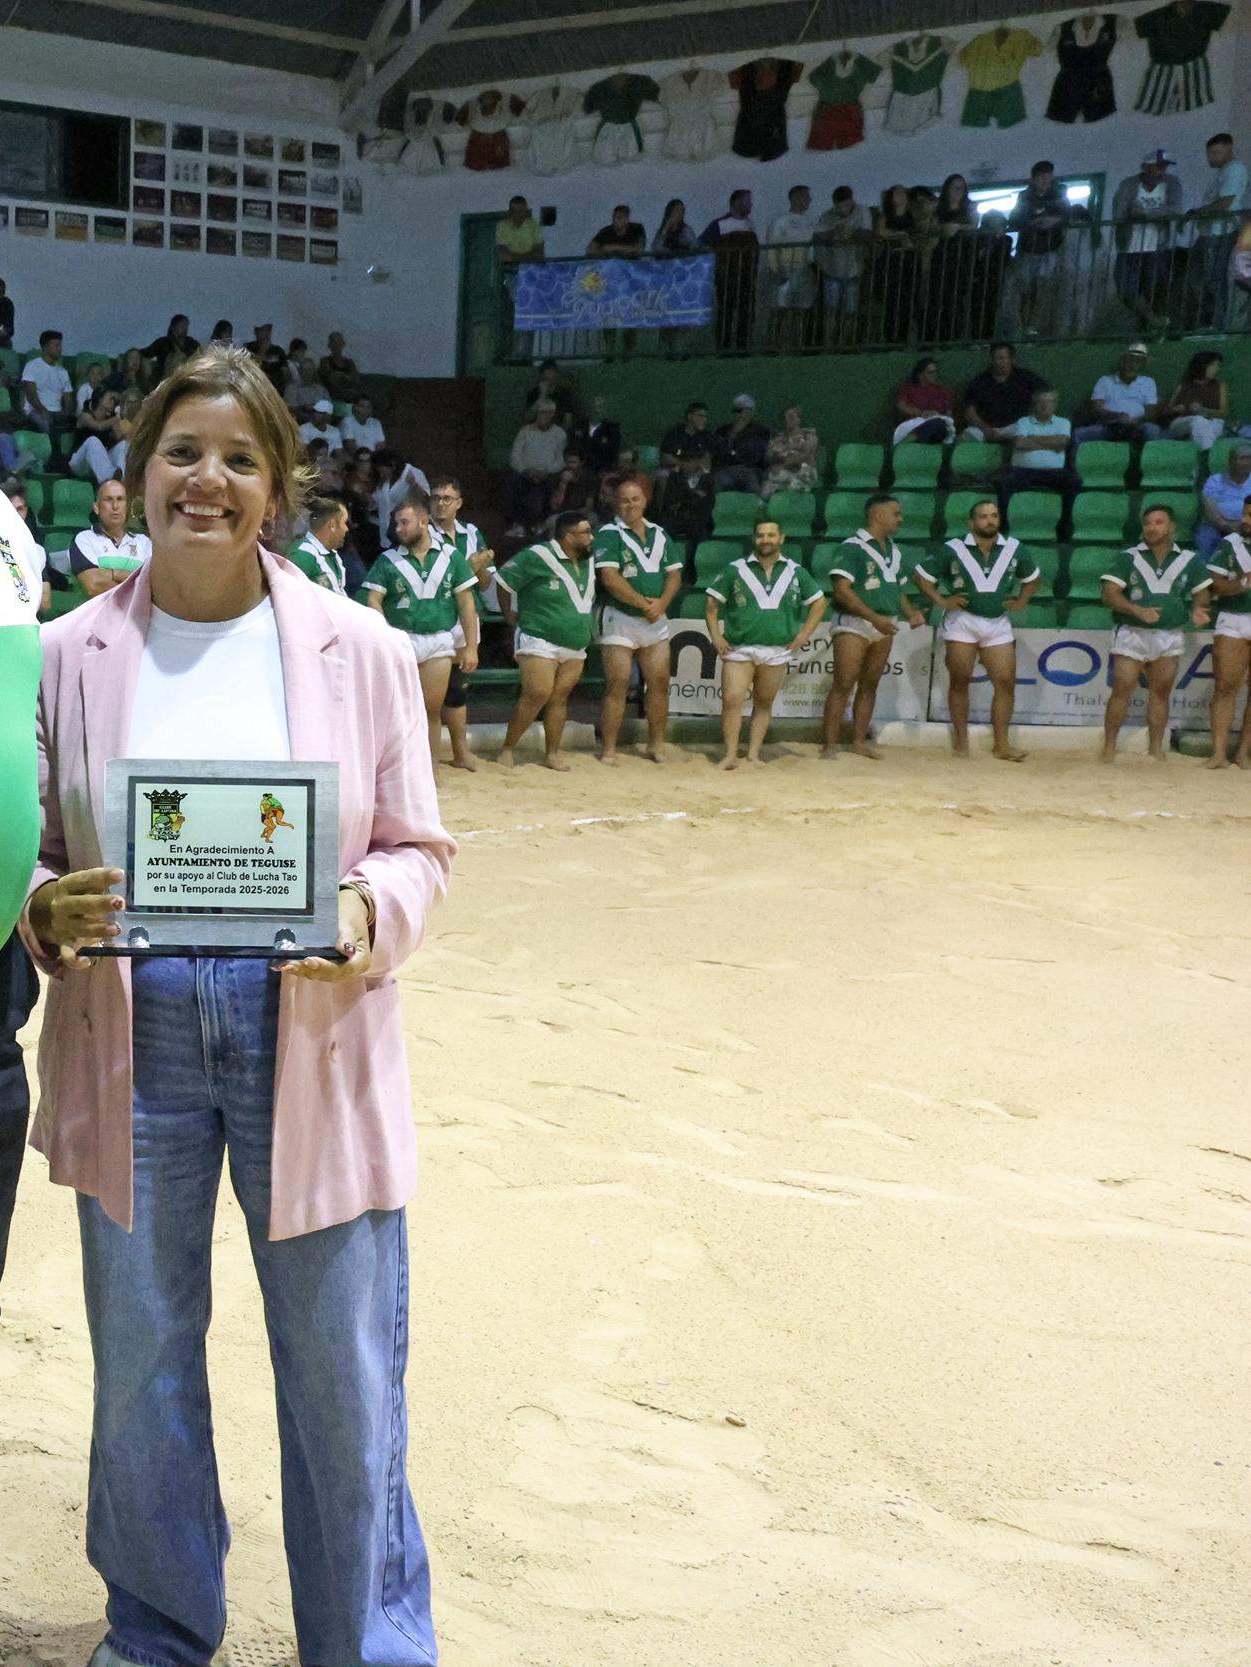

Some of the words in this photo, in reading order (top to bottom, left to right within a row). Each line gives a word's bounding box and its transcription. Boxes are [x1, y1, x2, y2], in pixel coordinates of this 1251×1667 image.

[170, 844, 183, 853] En
[185, 845, 265, 855] Agradecimiento
[267, 846, 275, 854] A
[147, 857, 231, 867] AYUNTAMIENTO
[234, 859, 248, 867] DE
[251, 859, 296, 868] TEGUISE
[147, 872, 162, 880] por
[177, 872, 204, 881] apoyo
[206, 871, 214, 880] al
[216, 872, 237, 880] Club
[239, 872, 250, 880] de
[252, 872, 279, 881] Lucha
[282, 872, 298, 881] Tao
[154, 885, 166, 893] en
[169, 884, 178, 893] la
[181, 884, 236, 895] Temporada
[239, 885, 290, 895] 2025-2026
